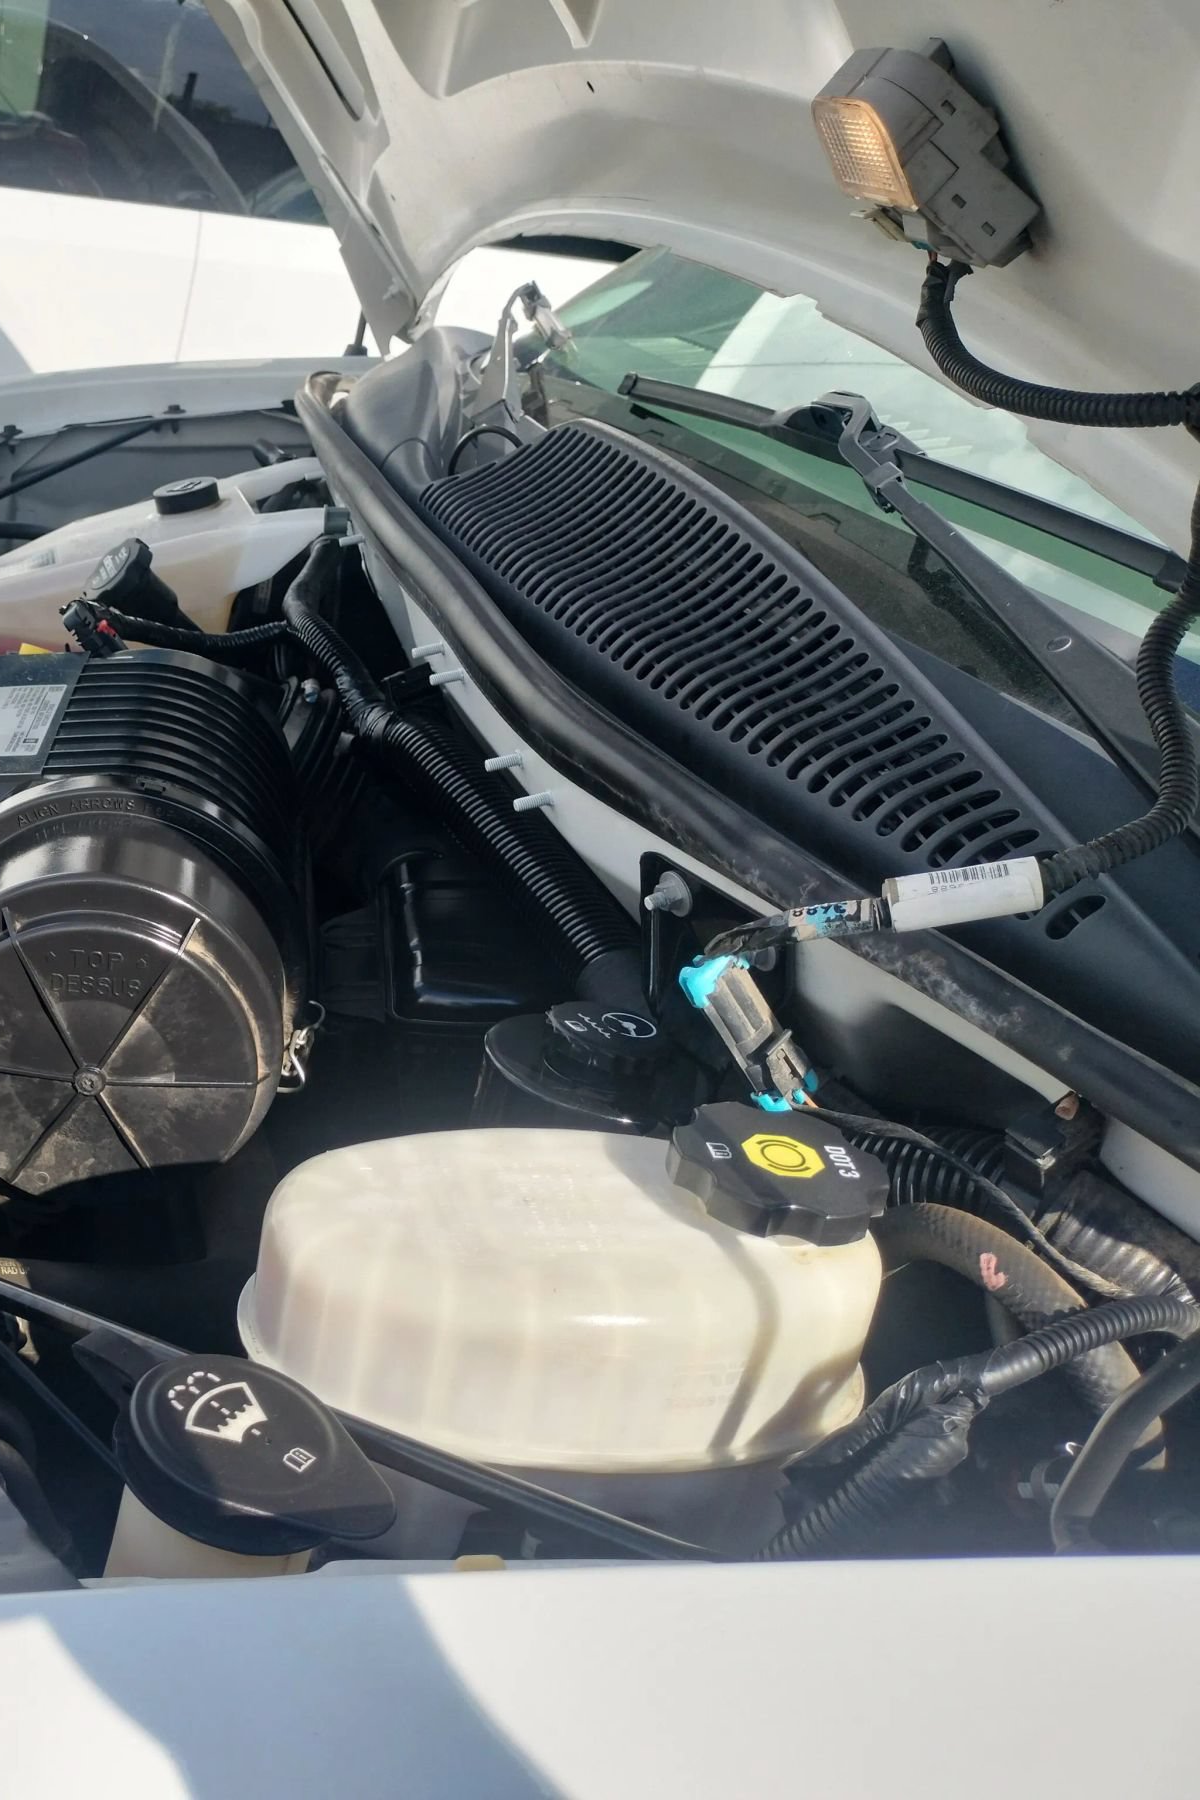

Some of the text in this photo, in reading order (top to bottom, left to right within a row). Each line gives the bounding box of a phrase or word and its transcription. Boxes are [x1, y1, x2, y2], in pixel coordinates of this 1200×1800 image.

[16, 803, 60, 827] ALIGN
[69, 798, 136, 812] ARROWS
[68, 949, 125, 971] TOP
[50, 972, 142, 997] DESSUS
[823, 1145, 860, 1178] DOT 3
